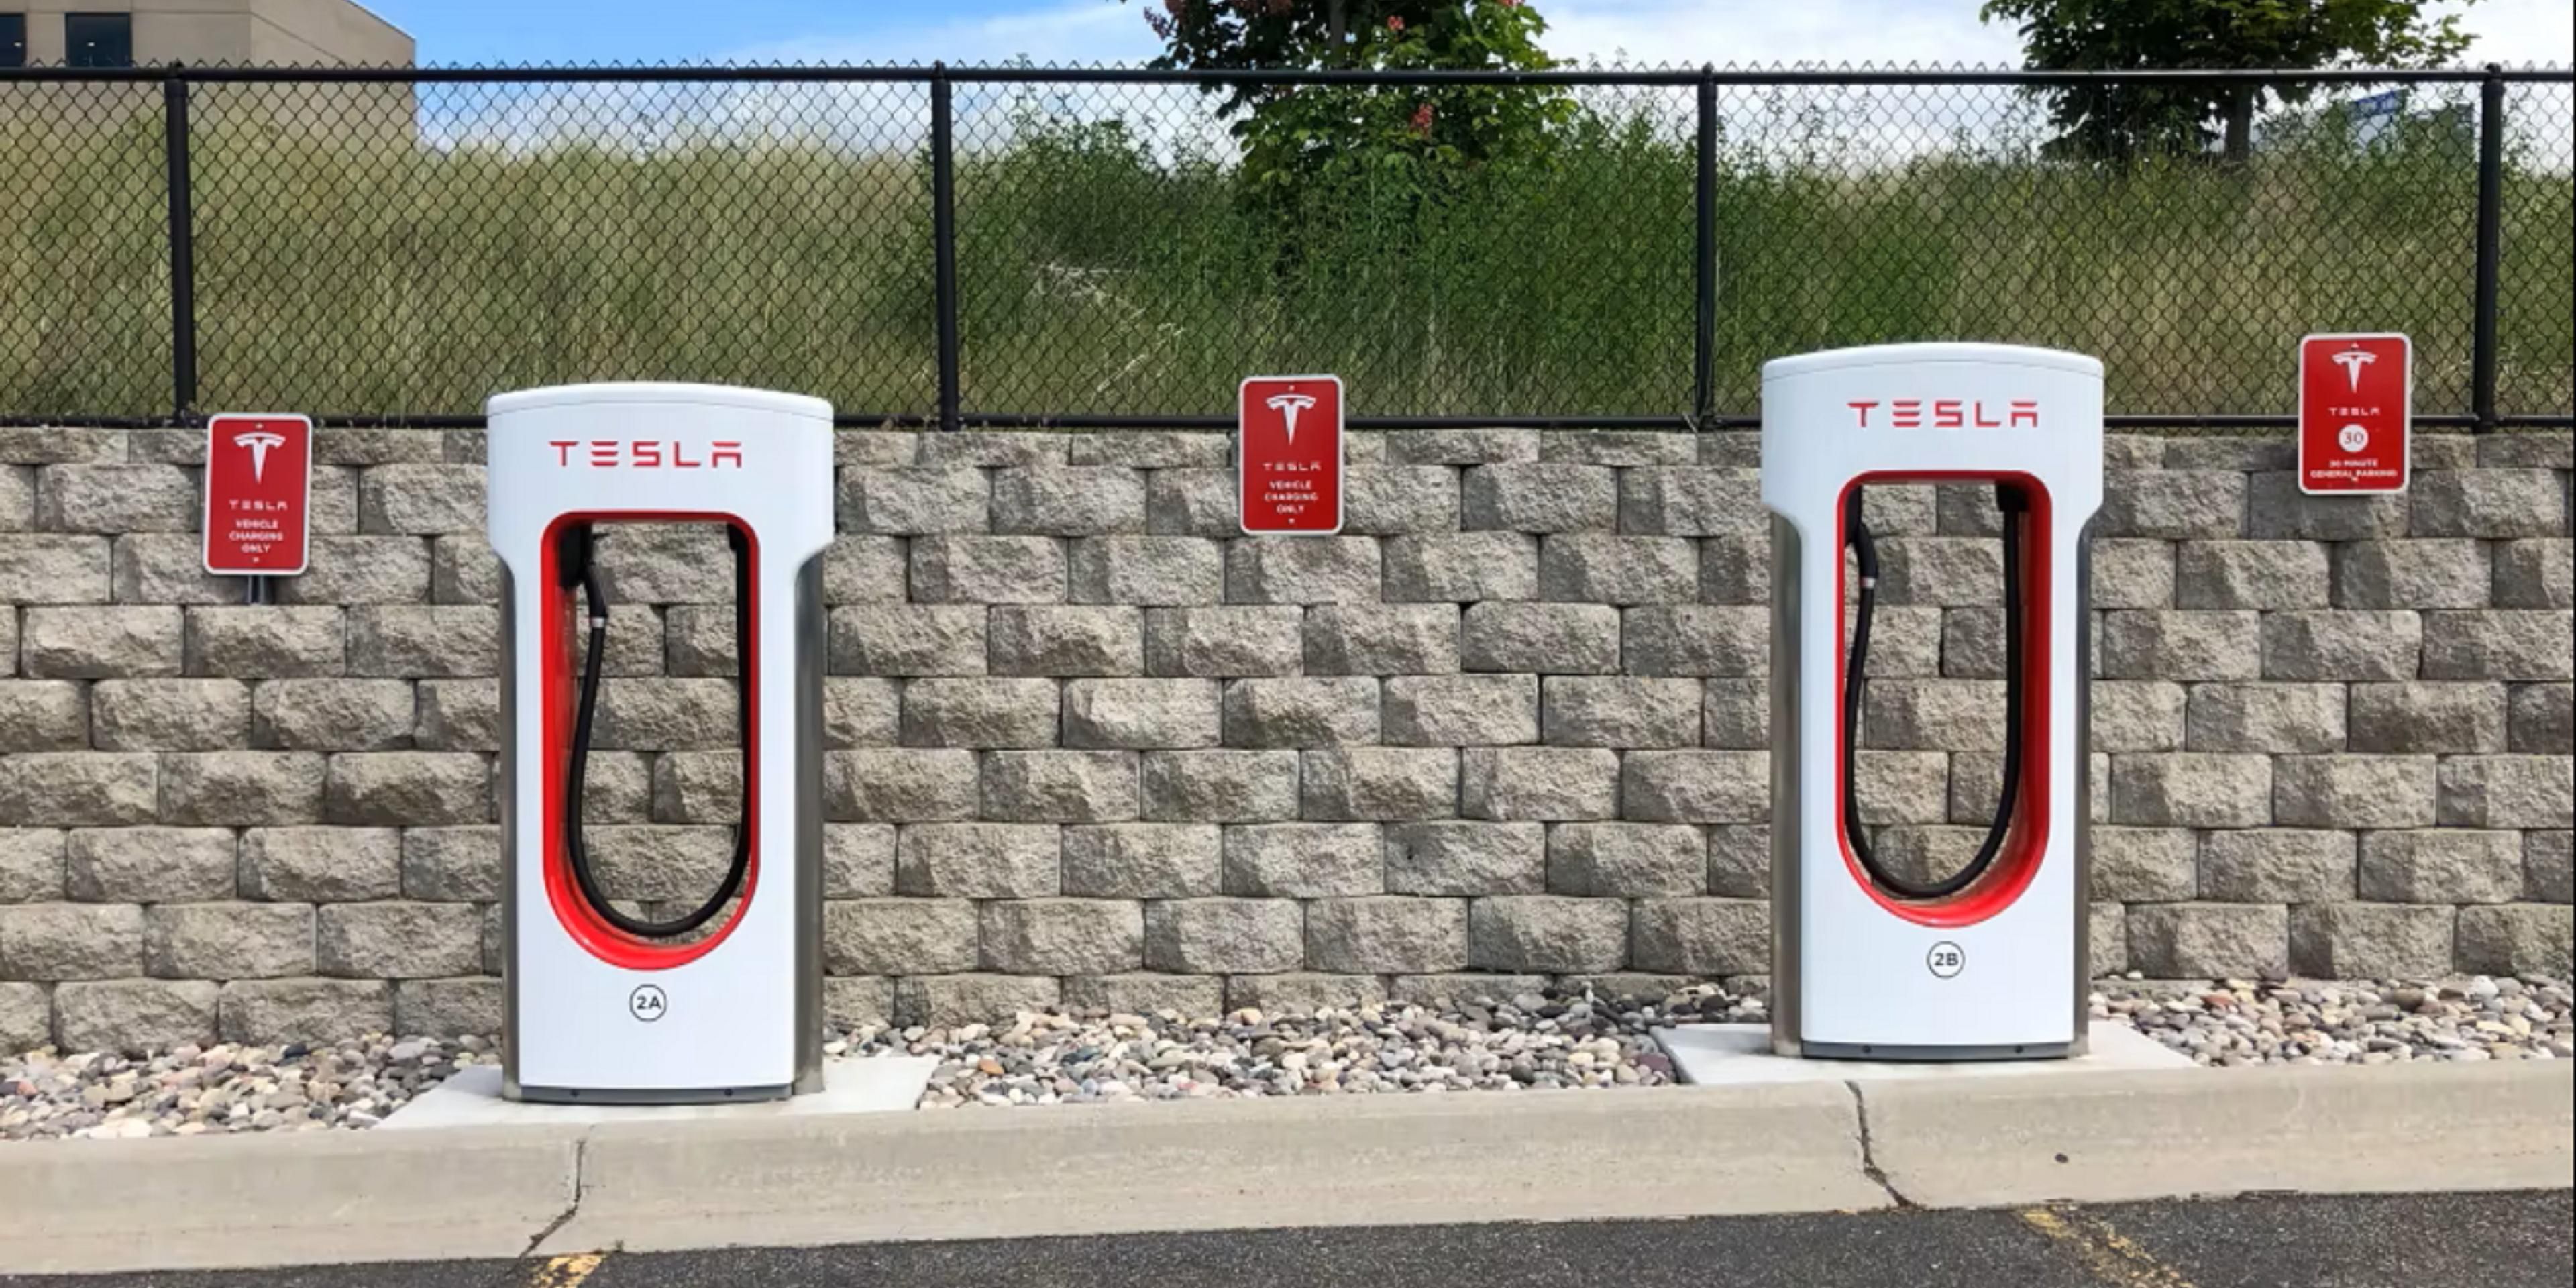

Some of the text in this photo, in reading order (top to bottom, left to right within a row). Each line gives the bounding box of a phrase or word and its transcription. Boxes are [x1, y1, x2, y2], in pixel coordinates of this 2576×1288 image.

[1847, 400, 2037, 427] TESLA
[2328, 407, 2380, 416] TESLA
[2343, 432, 2364, 444] 30
[549, 441, 742, 468] TESLA
[1263, 462, 1322, 471] TESLA
[2344, 459, 2378, 467] MINUTE
[1269, 481, 1311, 489] VEHICLE
[1264, 493, 1318, 501] CHARGING
[229, 500, 288, 511] TESLA
[1276, 504, 1304, 513] ONLY
[236, 519, 278, 529] VEHICLE
[229, 531, 283, 541] CHARGING
[241, 544, 271, 553] ONLY
[1934, 953, 1959, 966] 2B
[636, 996, 661, 1009] 2A
